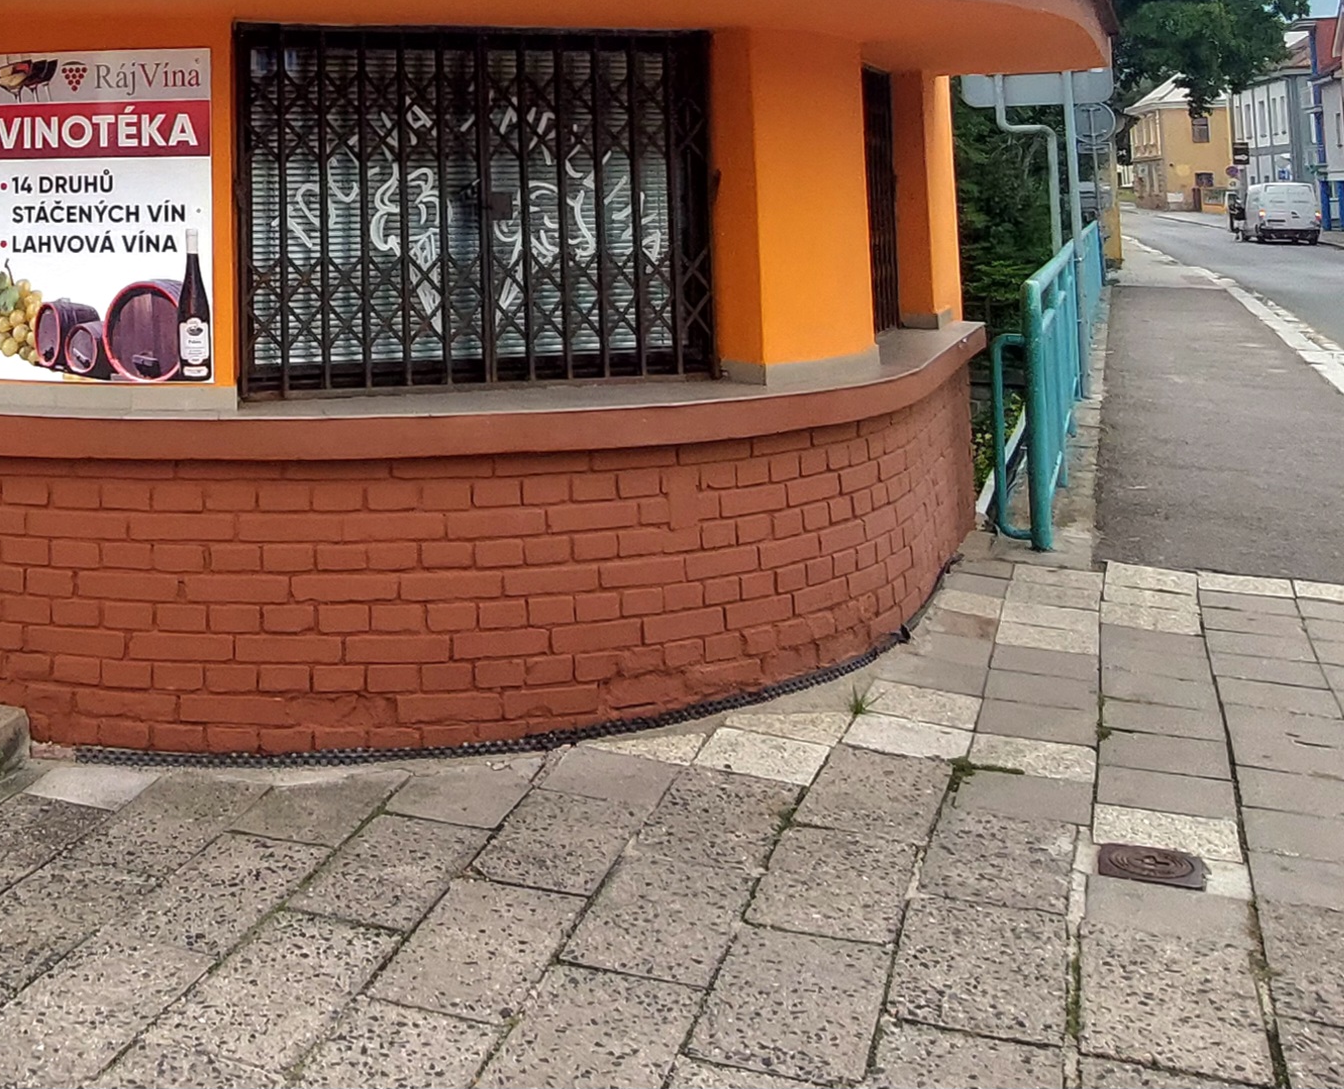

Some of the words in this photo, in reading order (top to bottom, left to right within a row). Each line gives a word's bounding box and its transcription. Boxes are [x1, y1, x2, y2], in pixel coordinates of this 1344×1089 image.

[11, 176, 33, 195] 14
[38, 168, 114, 194] DRUHŮ
[11, 199, 140, 224] STÁČENÝCH
[146, 199, 186, 223] VÍN
[11, 230, 116, 254] LAHVOVÁ
[121, 230, 178, 253] VÍNA
